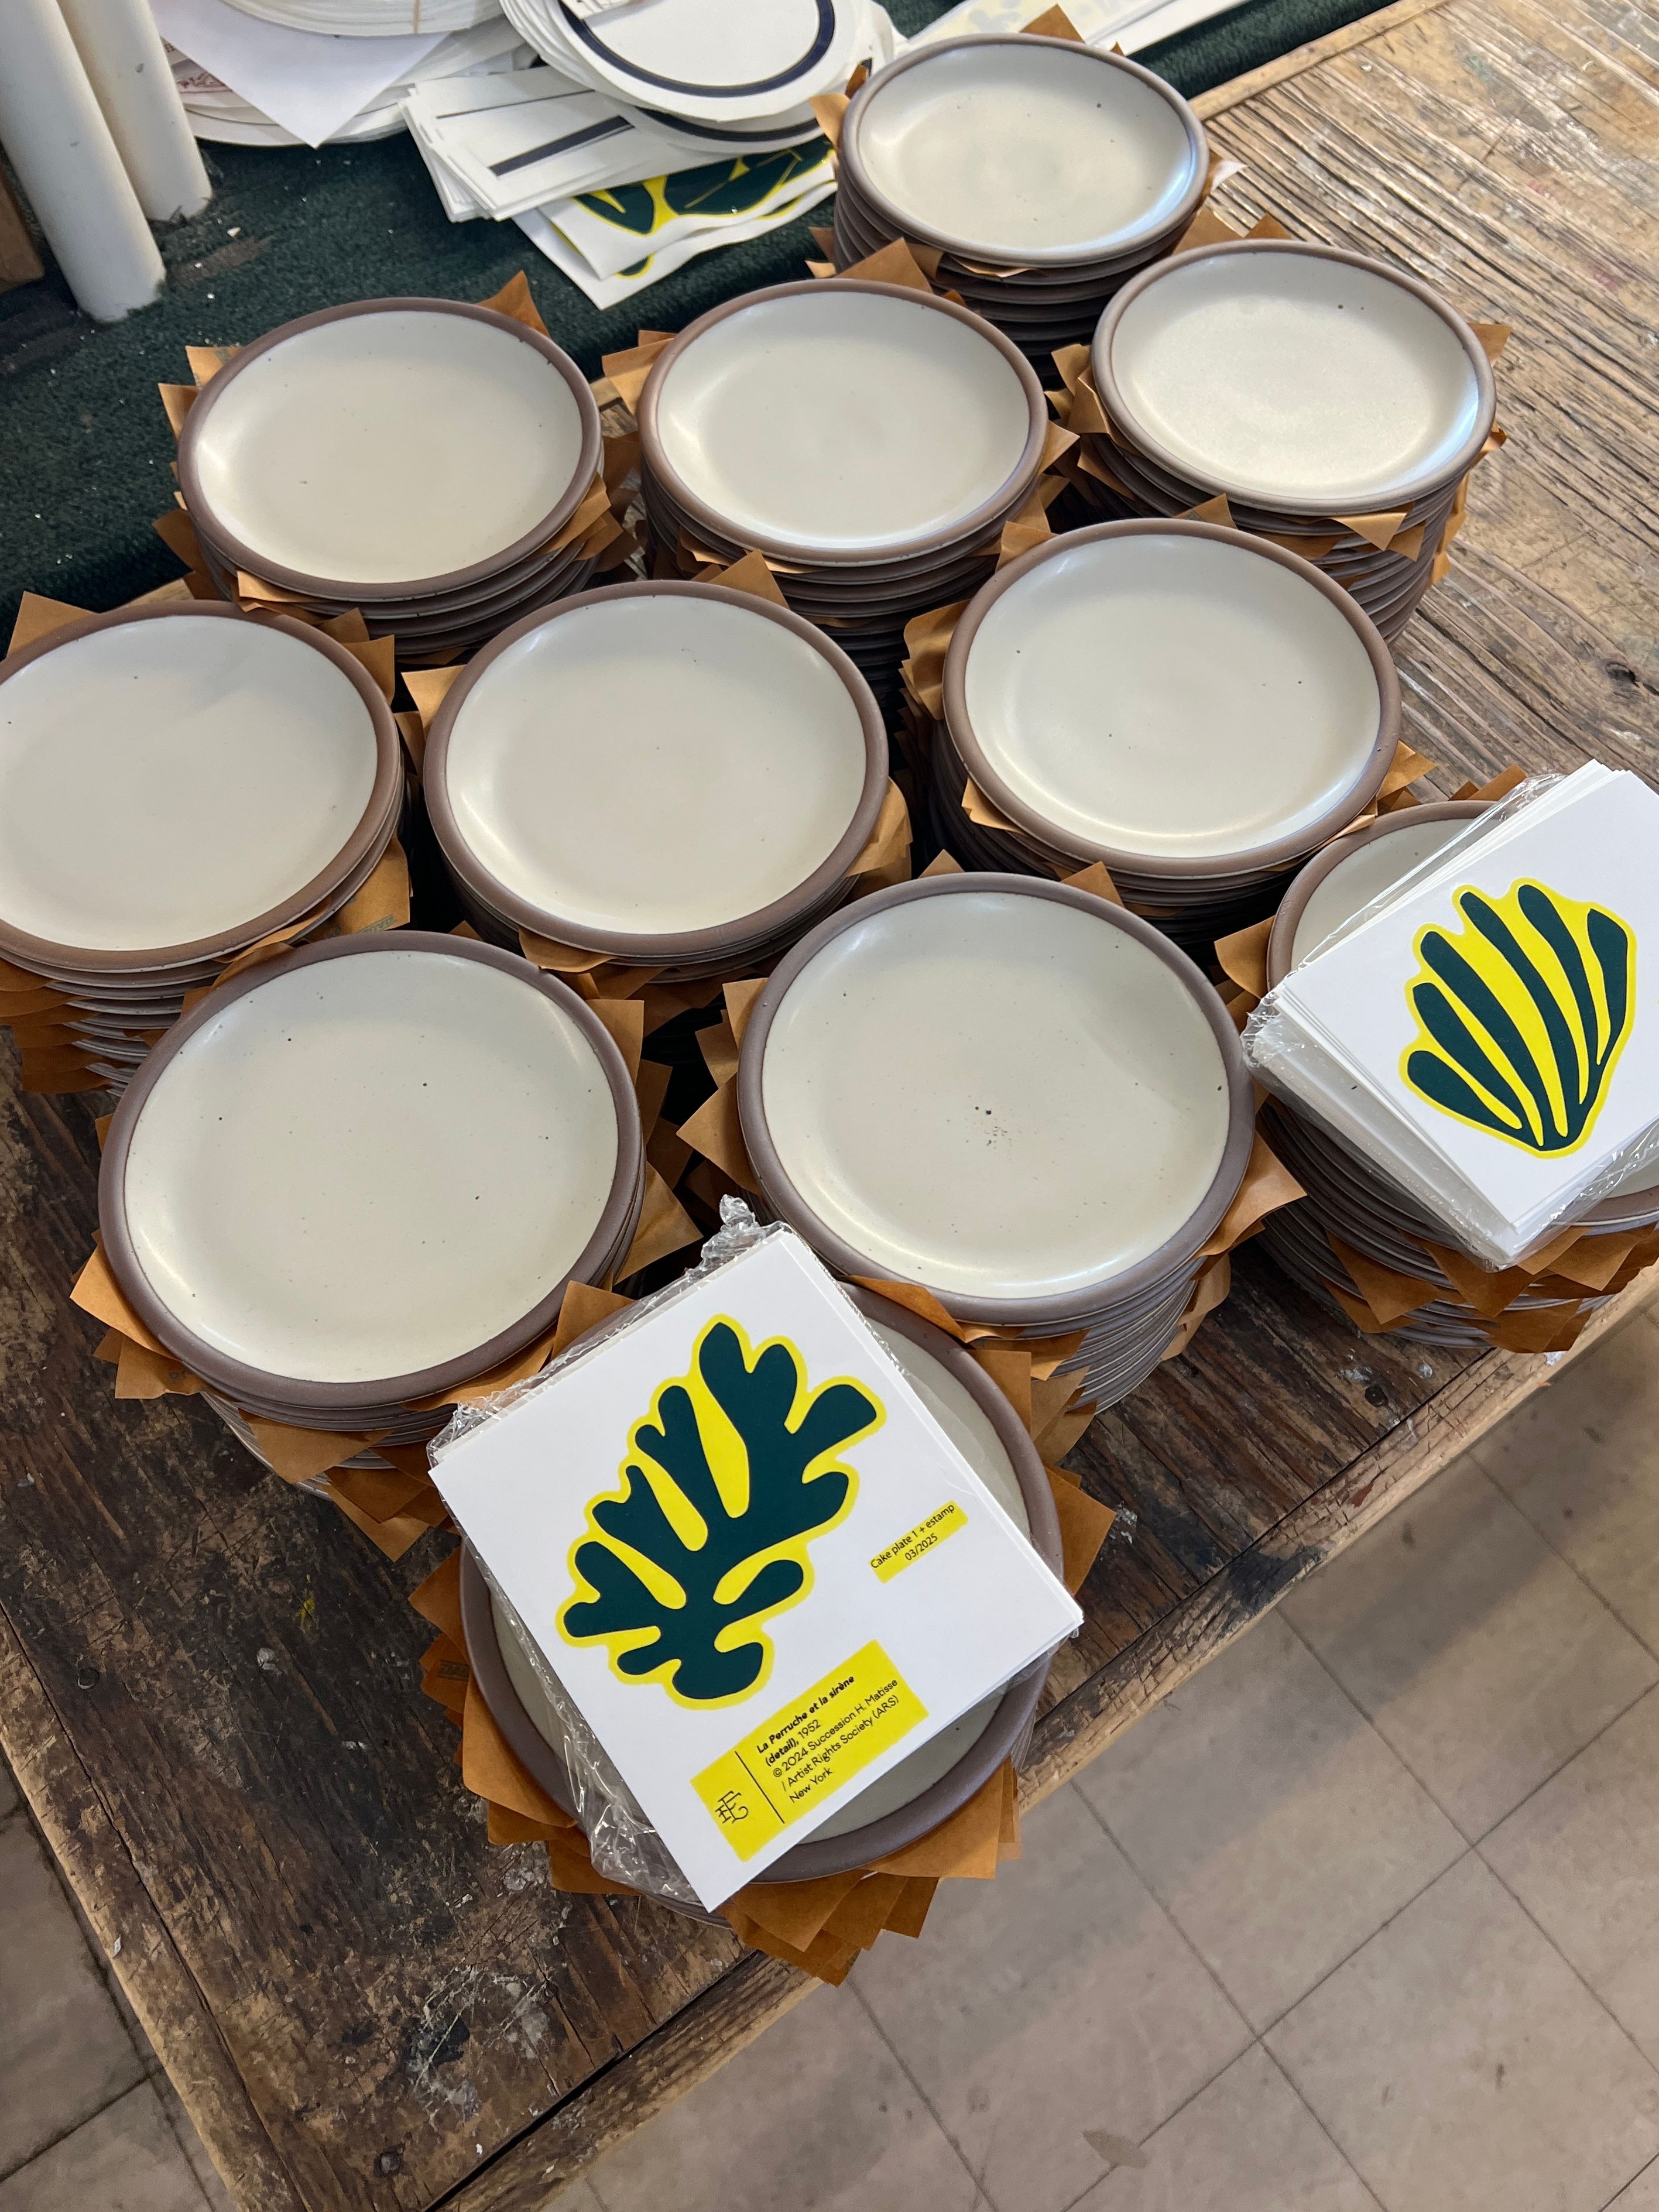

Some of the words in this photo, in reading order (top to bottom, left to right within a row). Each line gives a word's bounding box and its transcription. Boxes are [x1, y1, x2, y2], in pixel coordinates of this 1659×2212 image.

[870, 1551, 892, 1569] Cake
[891, 1535, 913, 1556] plate
[925, 1504, 955, 1528] estamp
[904, 1532, 938, 1561] 03/2025
[756, 1742, 769, 1754] La
[768, 1712, 808, 1744] Perruche
[809, 1703, 819, 1714] et
[818, 1696, 828, 1706] la
[829, 1676, 855, 1699] sirène
[765, 1737, 799, 1767] (detail),
[797, 1719, 821, 1739] 1952
[781, 1747, 809, 1772] 2024
[807, 1712, 856, 1751] Succession
[854, 1703, 867, 1715] H.
[865, 1679, 898, 1707] Matisse
[788, 1763, 814, 1787] Artist
[811, 1741, 841, 1767] Rights
[839, 1716, 873, 1745] Society
[872, 1694, 899, 1720] (ARS)
[789, 1784, 811, 1803] New
[810, 1767, 834, 1785] York
